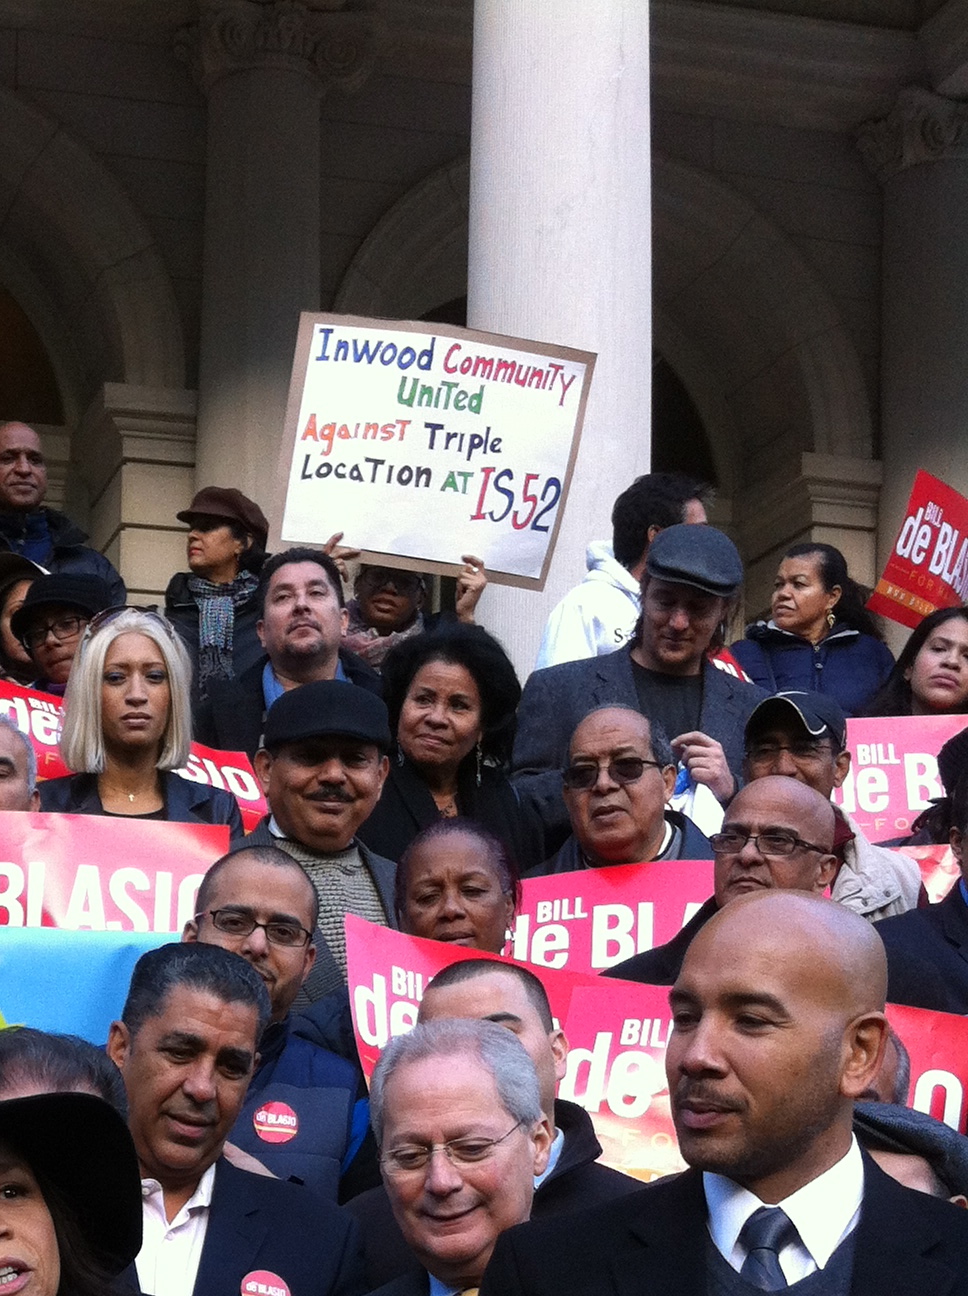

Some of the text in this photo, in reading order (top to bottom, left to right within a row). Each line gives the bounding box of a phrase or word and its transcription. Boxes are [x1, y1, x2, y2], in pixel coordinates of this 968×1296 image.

[440, 470, 474, 495] AT
[896, 506, 932, 565] de
[856, 743, 900, 766] BILL
[874, 818, 908, 831] FO
[536, 896, 588, 924] BILL
[391, 965, 434, 1002] BIL
